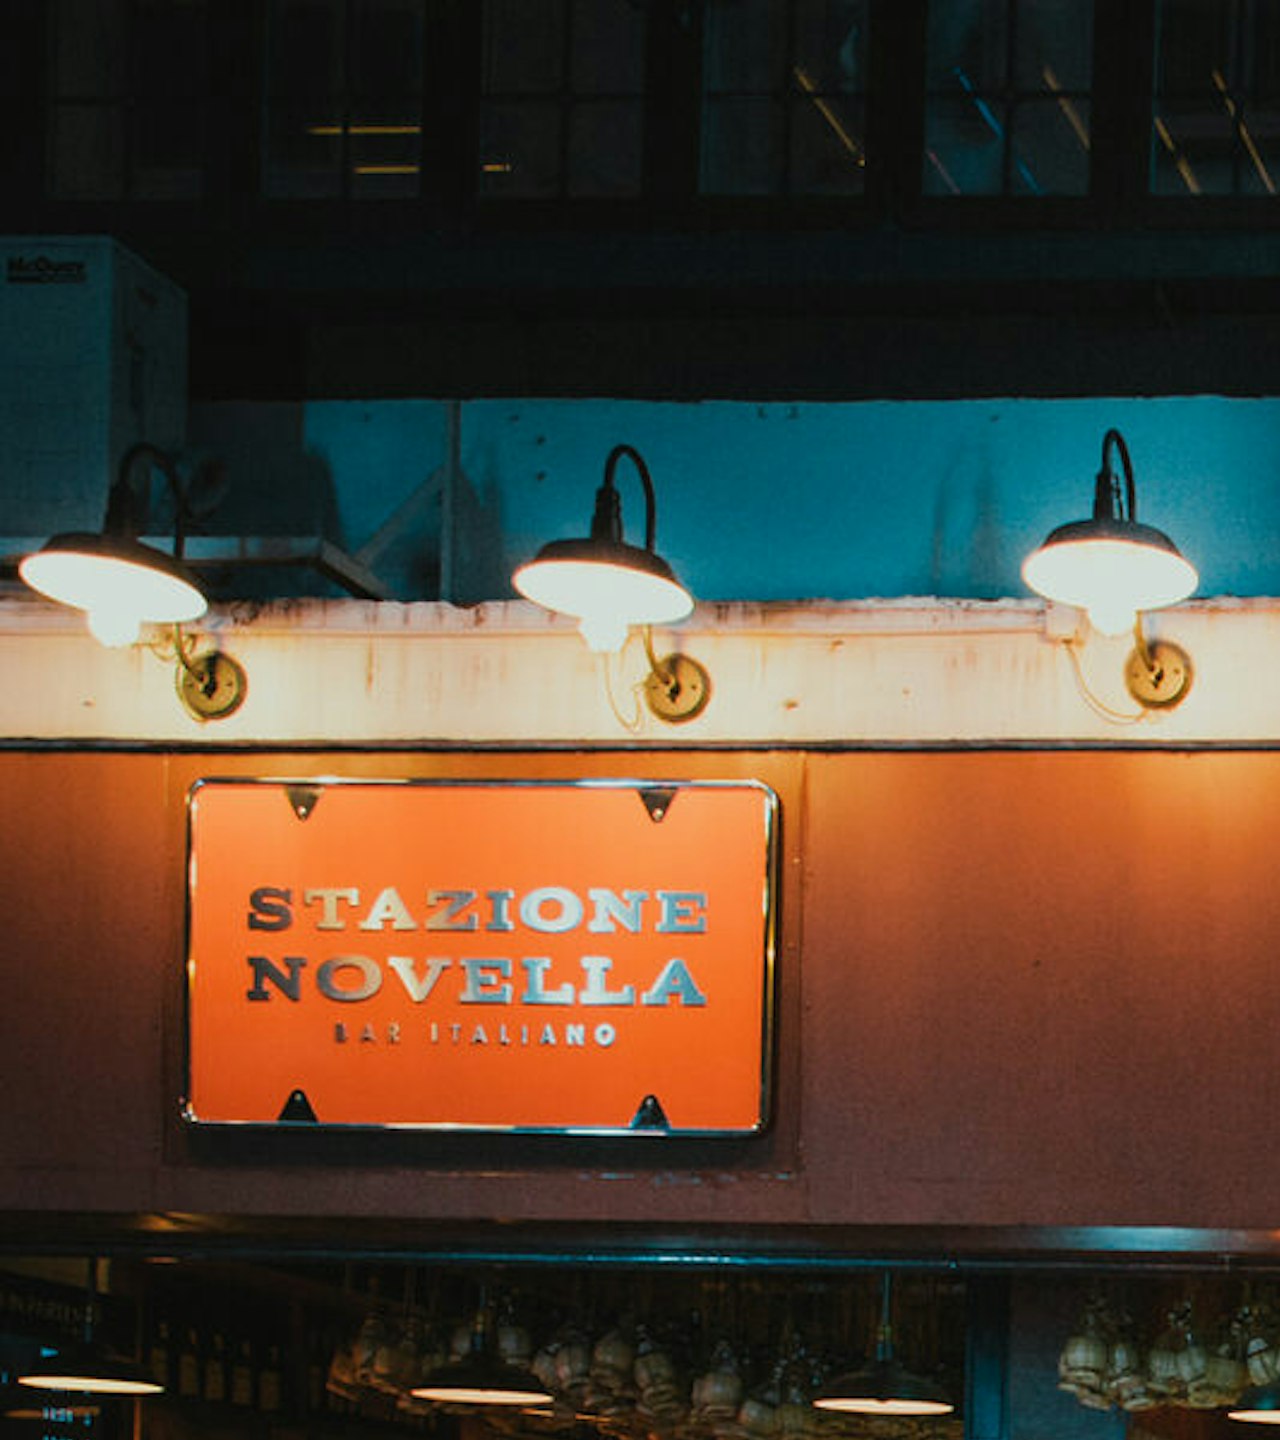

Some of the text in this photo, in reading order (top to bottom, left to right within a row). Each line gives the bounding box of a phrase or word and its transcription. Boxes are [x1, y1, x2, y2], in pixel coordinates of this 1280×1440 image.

[247, 886, 706, 933] STAZIONE
[246, 955, 707, 1007] NOVELLA
[333, 1022, 618, 1047] BAR ITALIANO
